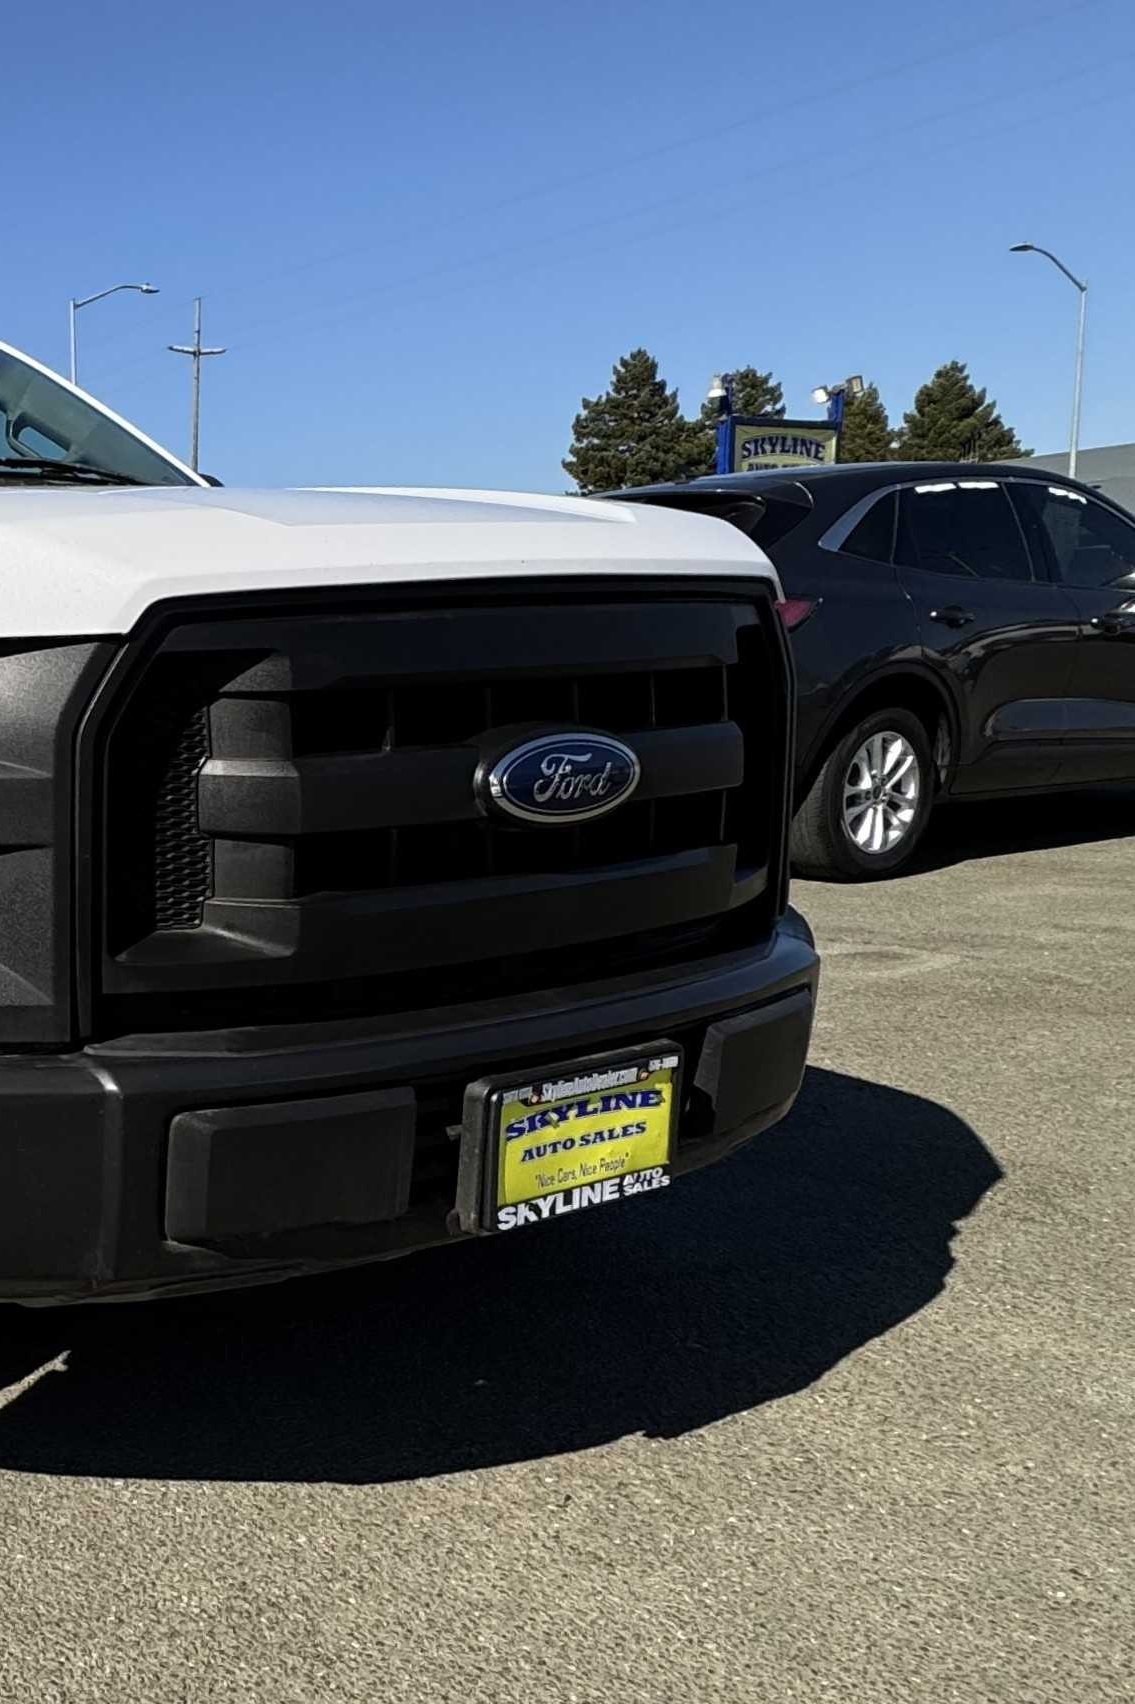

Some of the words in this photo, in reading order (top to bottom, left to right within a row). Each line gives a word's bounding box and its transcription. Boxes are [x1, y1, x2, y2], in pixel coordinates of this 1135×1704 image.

[741, 436, 825, 460] SKYLINE
[534, 752, 613, 802] Ford
[505, 1089, 664, 1141] SKYLINE
[521, 1138, 575, 1162] AUTO
[579, 1121, 647, 1146] SALES
[579, 1161, 598, 1176] Nice
[623, 1166, 664, 1186] AUTO
[623, 1174, 671, 1197] SALES
[496, 1177, 620, 1231] SKYLINE
